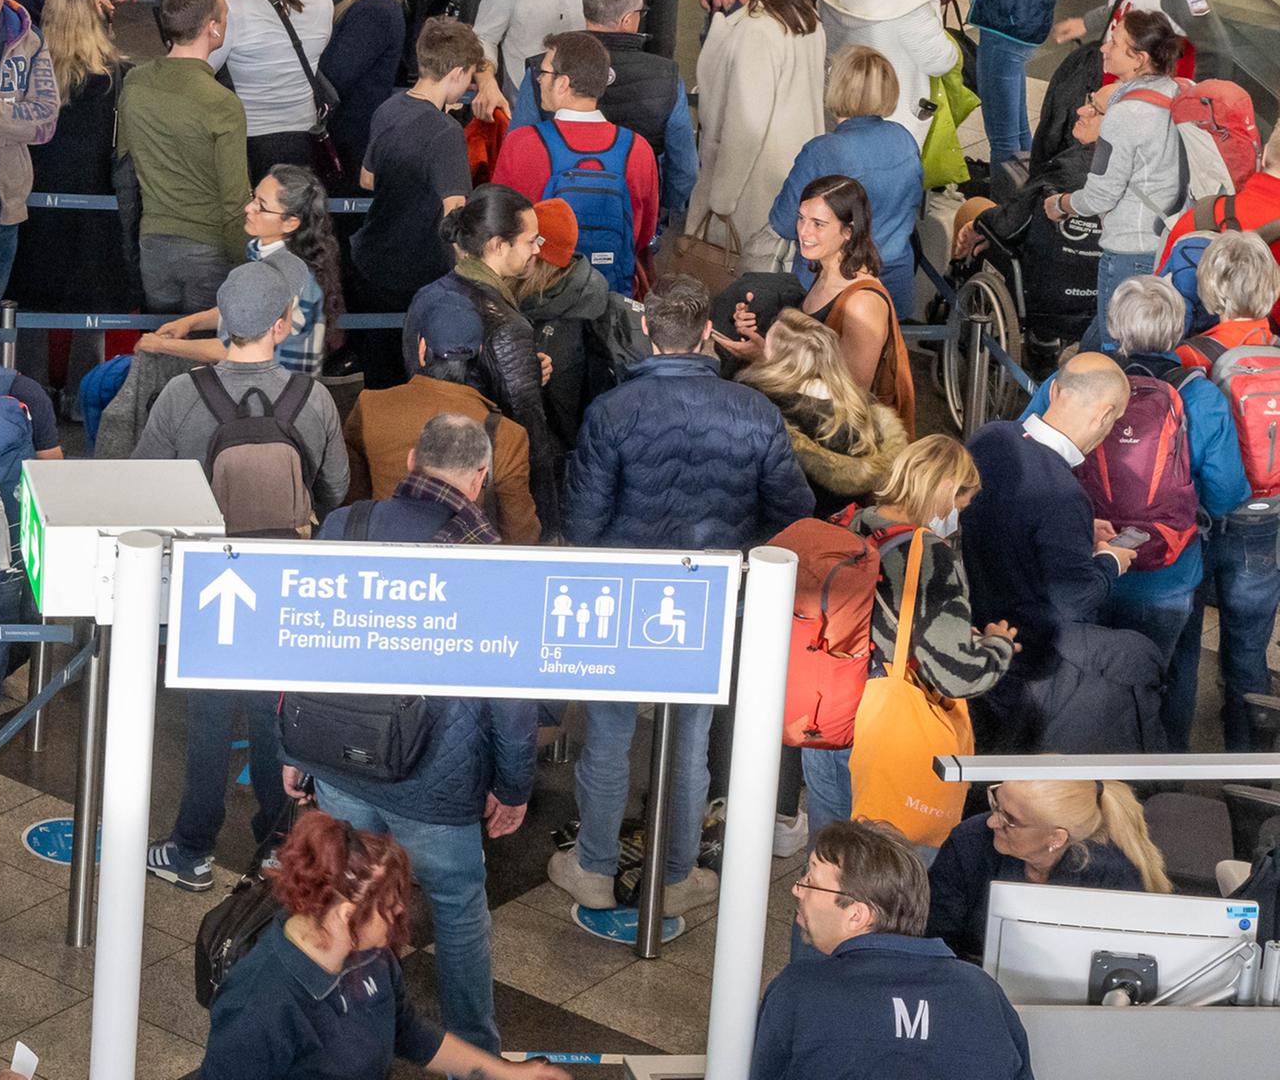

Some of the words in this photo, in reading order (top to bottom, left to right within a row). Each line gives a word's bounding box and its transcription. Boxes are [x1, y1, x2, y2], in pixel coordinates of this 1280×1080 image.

[281, 569, 348, 599] Fast
[358, 571, 447, 601] Track
[280, 607, 324, 628] First,
[333, 609, 416, 629] Business
[423, 613, 457, 630] and
[279, 629, 360, 648] Premium
[368, 632, 473, 655] Passengers
[480, 636, 518, 657] only
[541, 647, 561, 659] 0-6
[539, 660, 615, 676] Jahre/years
[893, 998, 929, 1040] M
